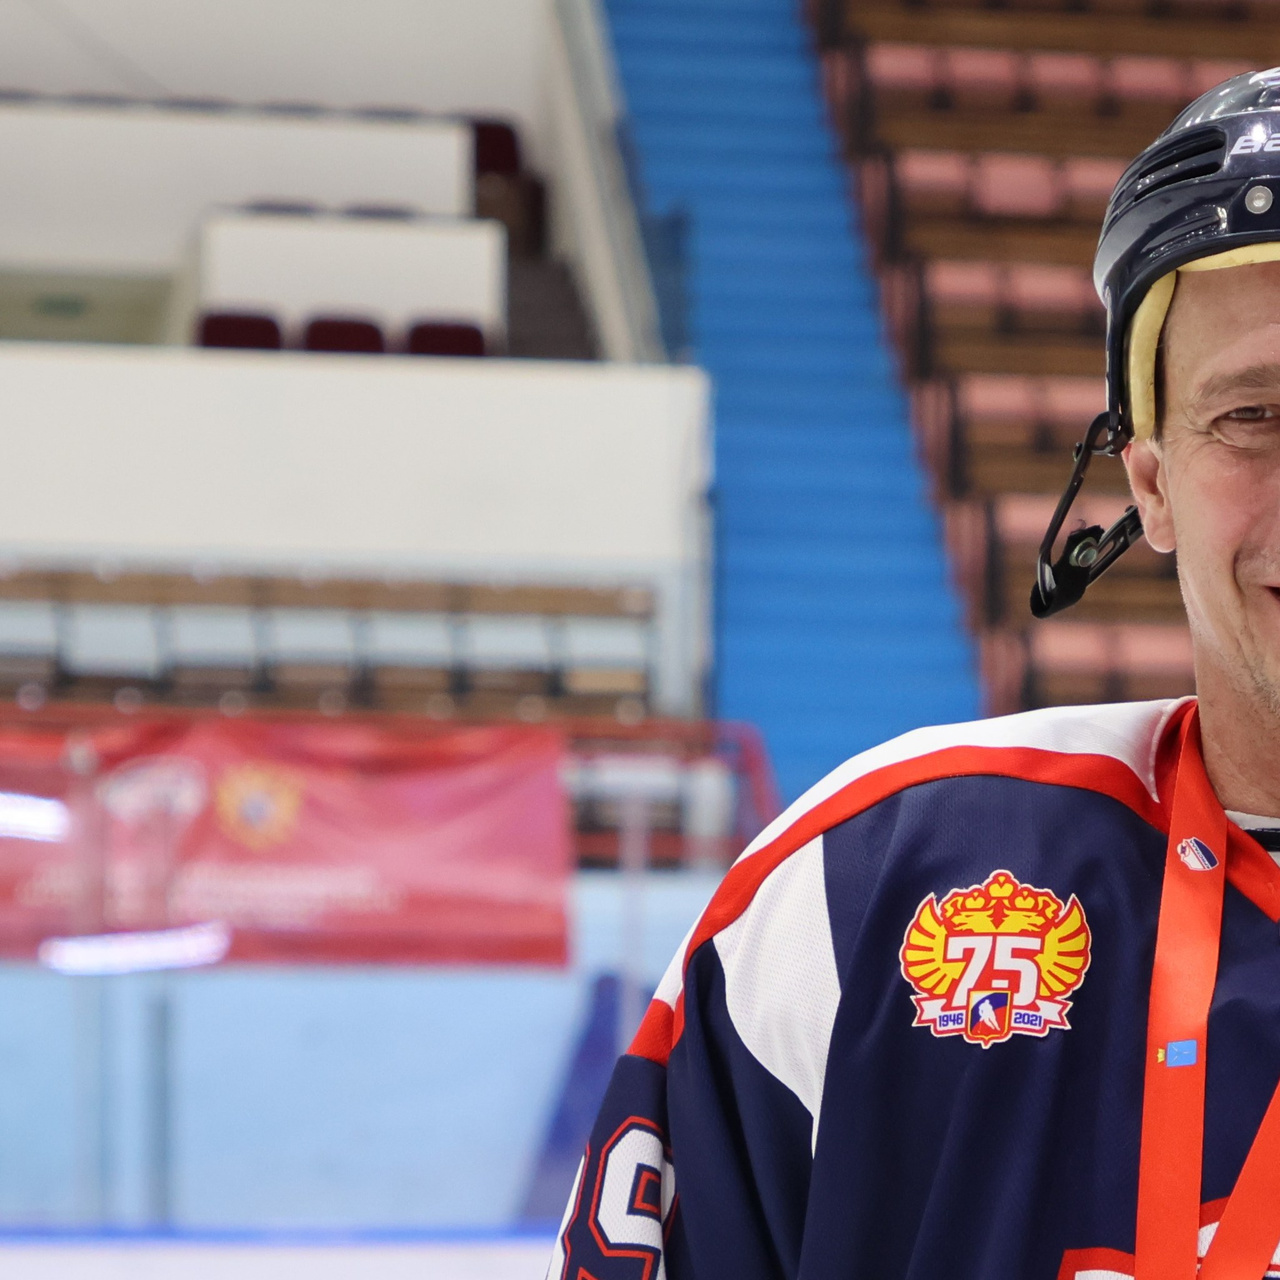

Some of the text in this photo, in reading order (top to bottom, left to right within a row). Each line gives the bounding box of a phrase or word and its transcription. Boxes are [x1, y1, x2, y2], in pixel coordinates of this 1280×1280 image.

[946, 935, 1042, 1008] 75
[938, 1012, 964, 1028] 1946
[1013, 1011, 1042, 1028] 2021
